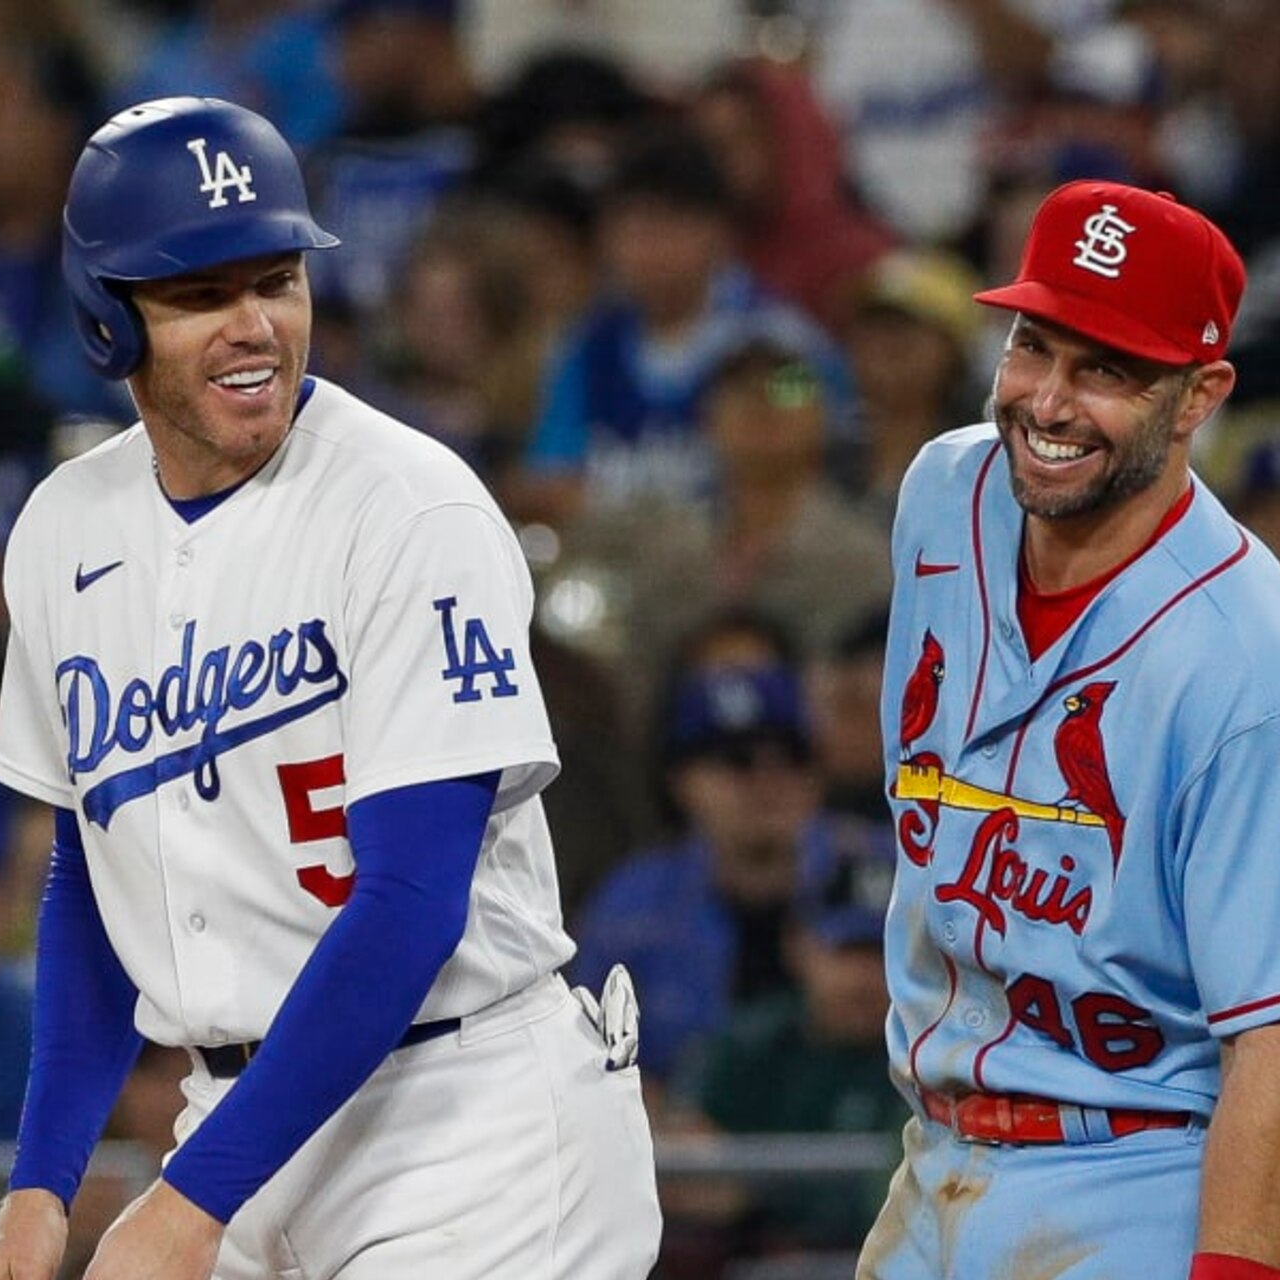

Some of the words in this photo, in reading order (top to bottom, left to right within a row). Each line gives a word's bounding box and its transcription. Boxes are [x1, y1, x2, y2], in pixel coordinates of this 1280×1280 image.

[186, 137, 257, 209] LA
[56, 618, 348, 801] Dodgers
[433, 596, 520, 703] LA
[277, 753, 356, 908] 5
[934, 806, 1093, 941] Louis
[1006, 971, 1165, 1073] 46
